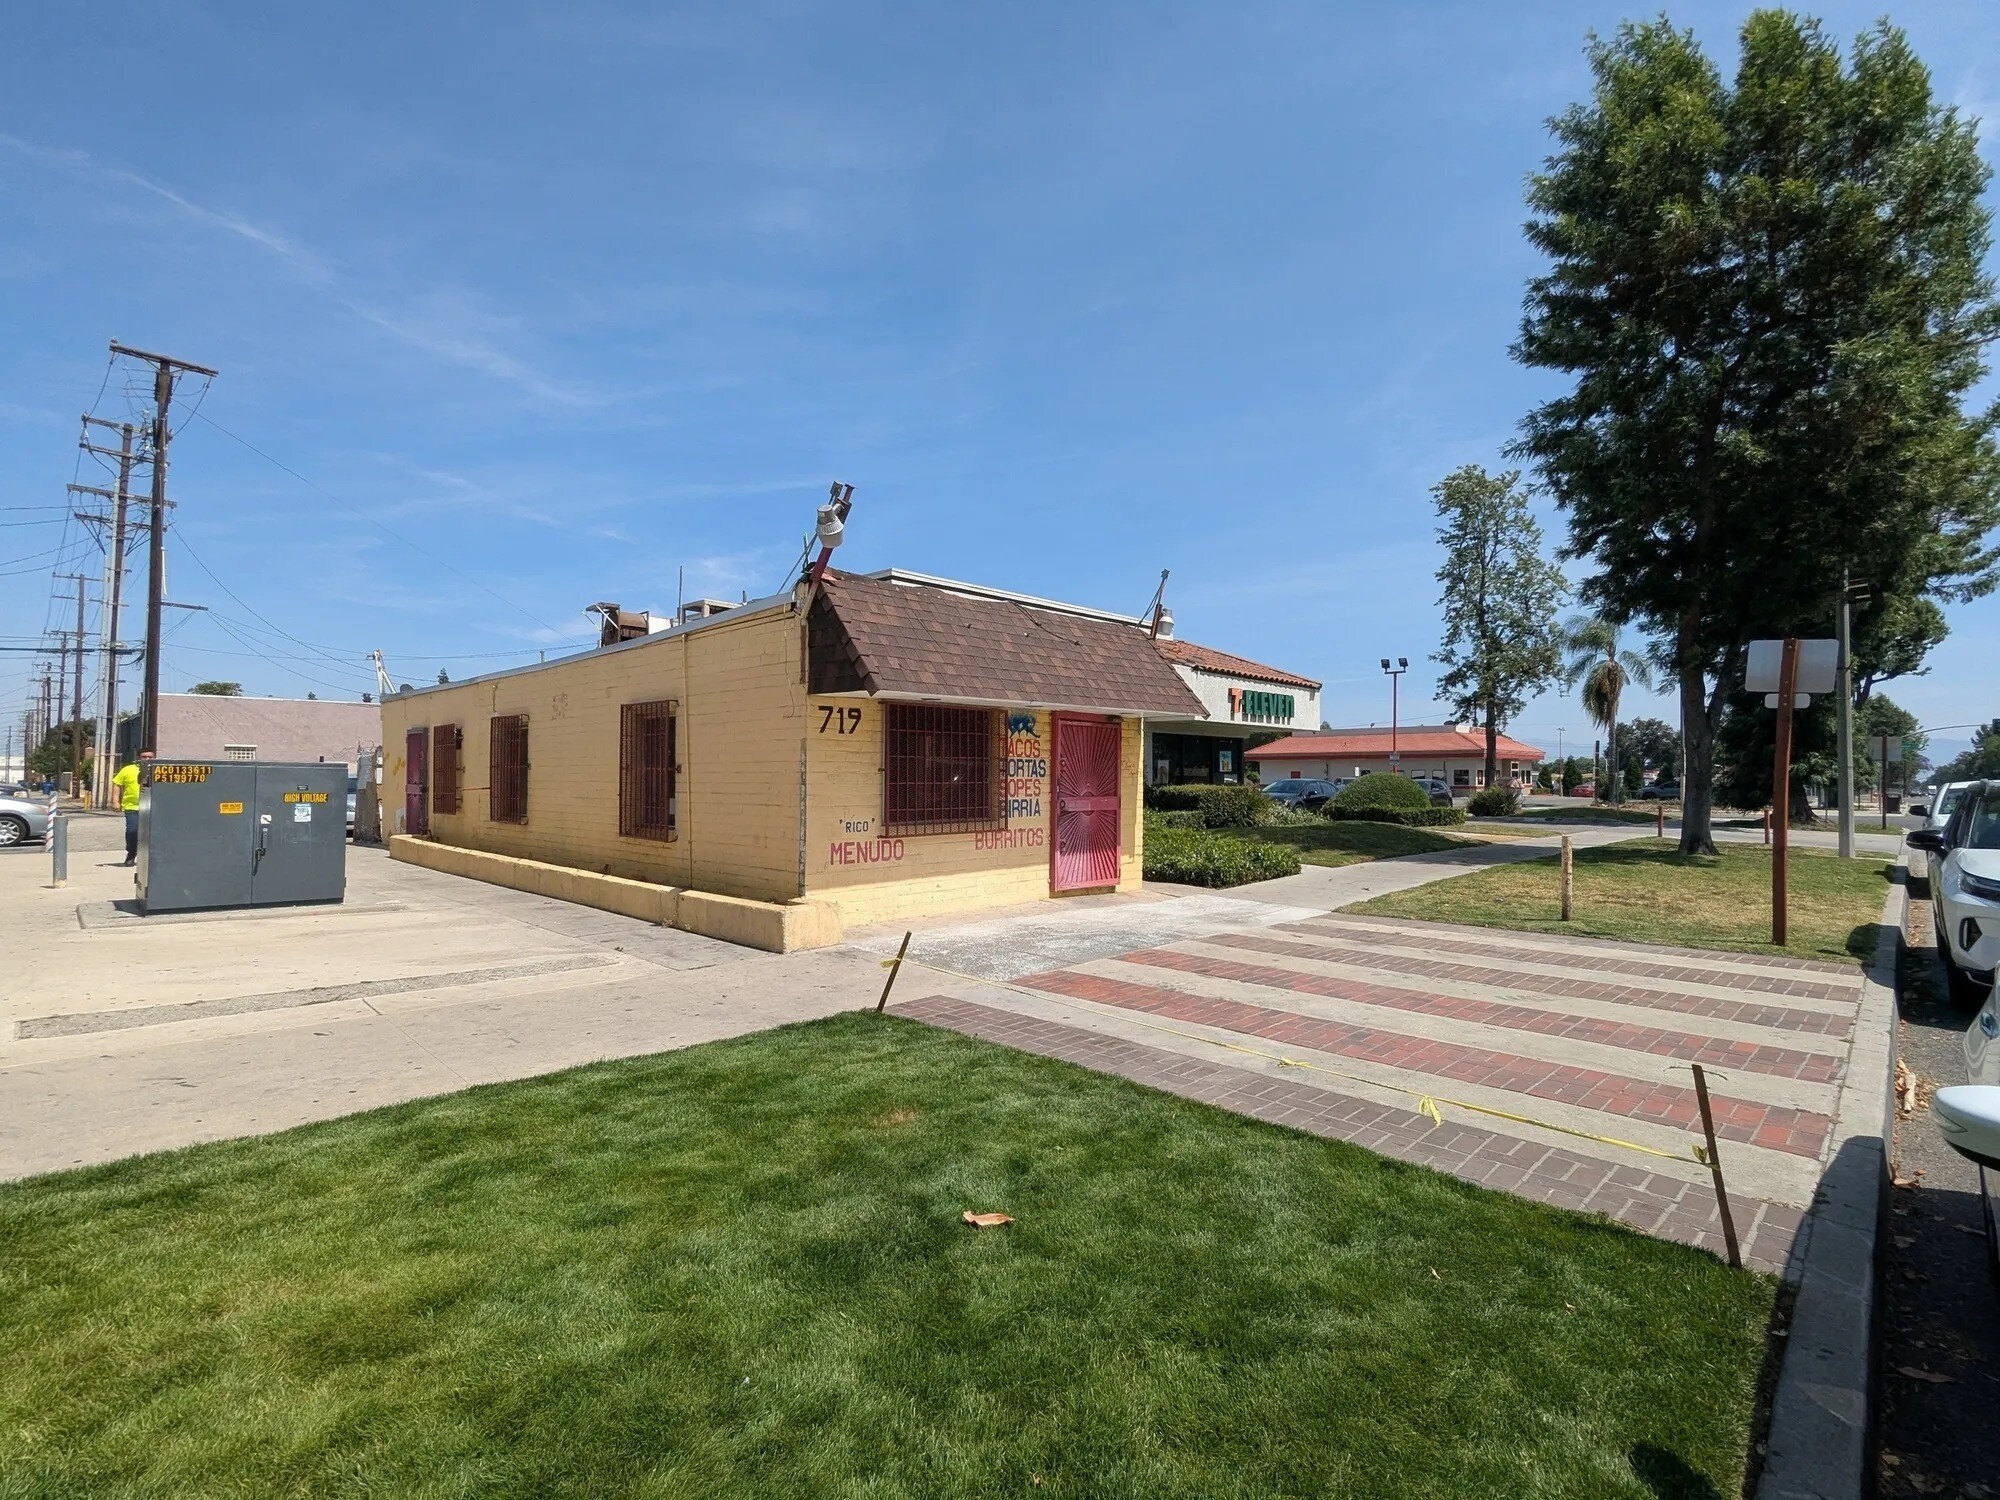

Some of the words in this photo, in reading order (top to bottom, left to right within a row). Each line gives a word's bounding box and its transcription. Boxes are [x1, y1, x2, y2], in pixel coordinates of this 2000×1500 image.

[818, 705, 862, 734] 719
[284, 793, 300, 803] HIGH
[301, 793, 328, 803] VOLTAGE
[975, 828, 1044, 850] BURRITOS
[830, 839, 905, 865] MENUDO
